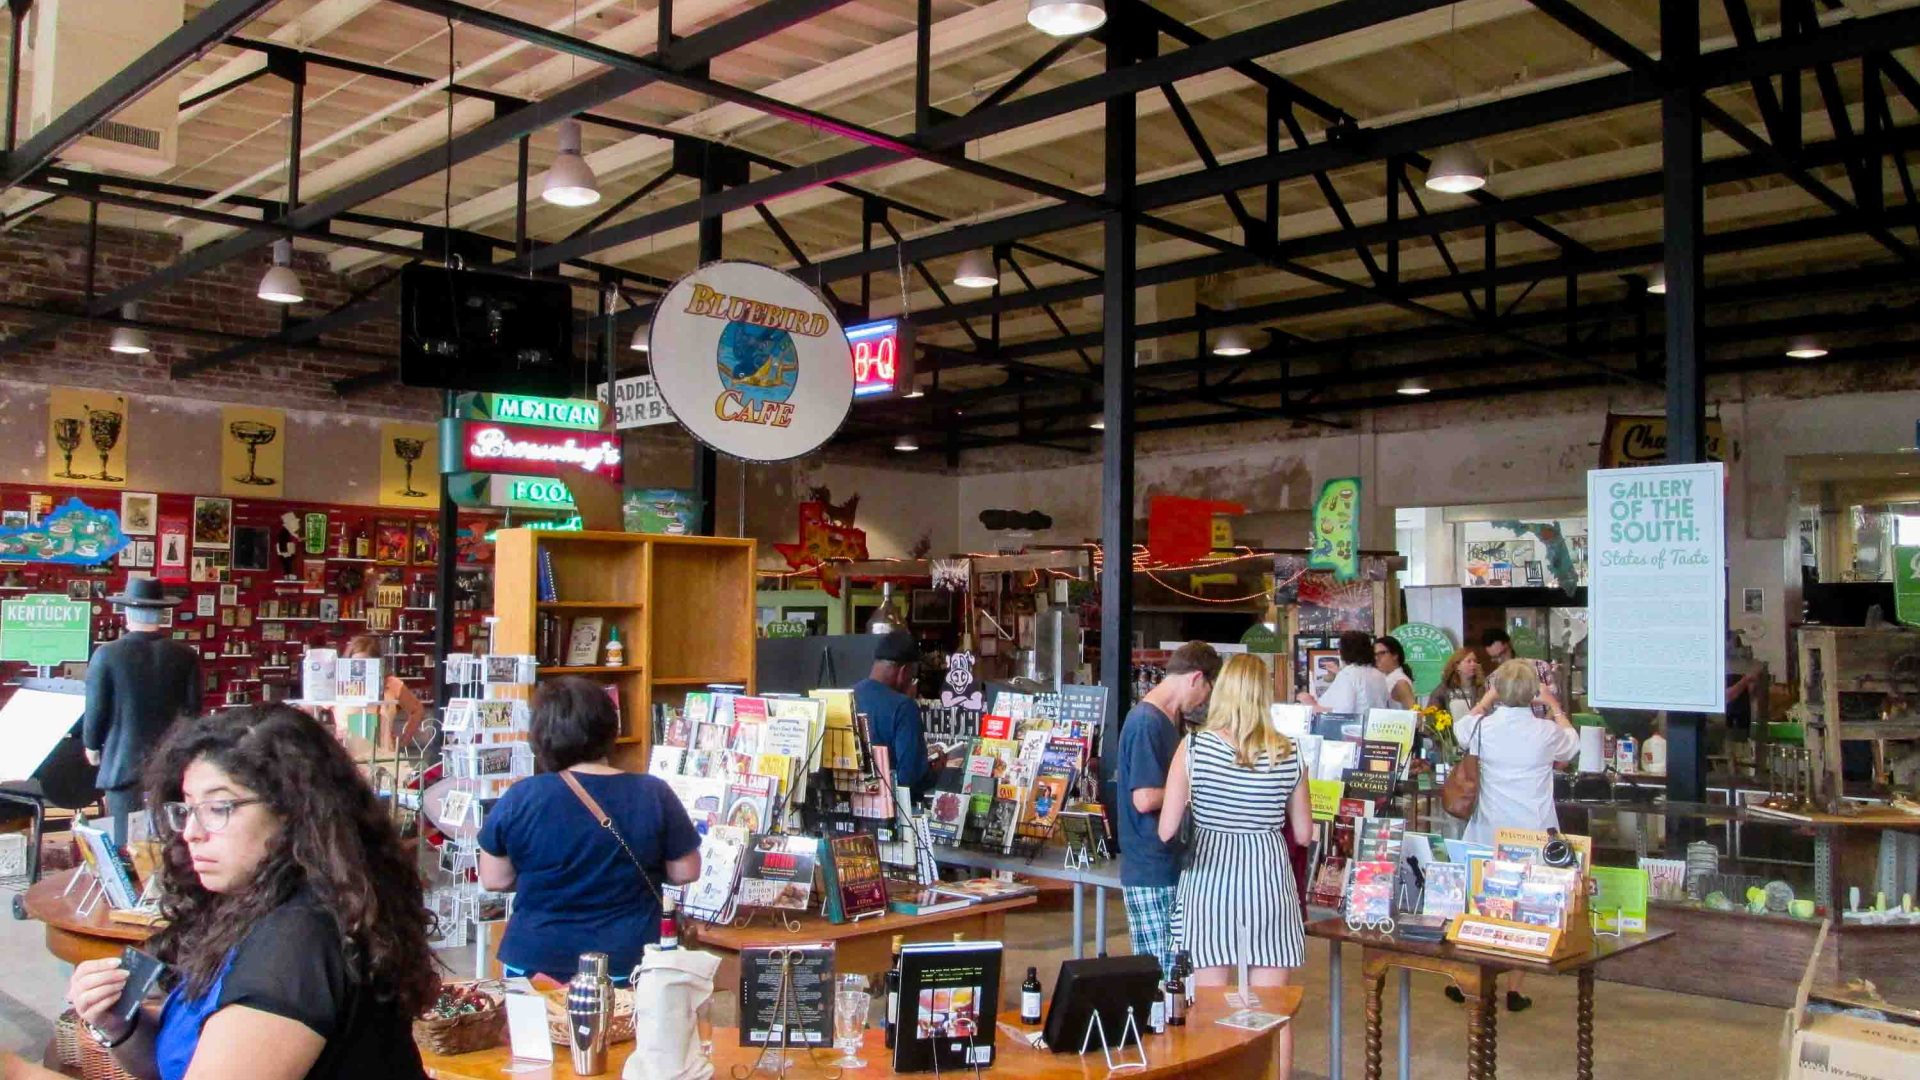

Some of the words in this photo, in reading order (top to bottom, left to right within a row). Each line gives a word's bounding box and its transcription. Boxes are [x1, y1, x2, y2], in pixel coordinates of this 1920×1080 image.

[684, 284, 829, 337] BLUEBIRD
[499, 398, 598, 425] MEXICAN
[715, 390, 795, 428] CAFE
[513, 481, 573, 502] FOO
[1609, 480, 1693, 499] GALLERY
[1610, 500, 1642, 520] OF
[1652, 498, 1694, 519] THE
[1610, 521, 1700, 543] SOUTH:
[1601, 551, 1647, 572] States
[1650, 553, 1667, 575] of
[1670, 549, 1710, 571] Taste
[8, 605, 83, 621] KENTUCKY
[771, 623, 803, 633] TEXAS
[1350, 782, 1388, 790] COCKTAILS
